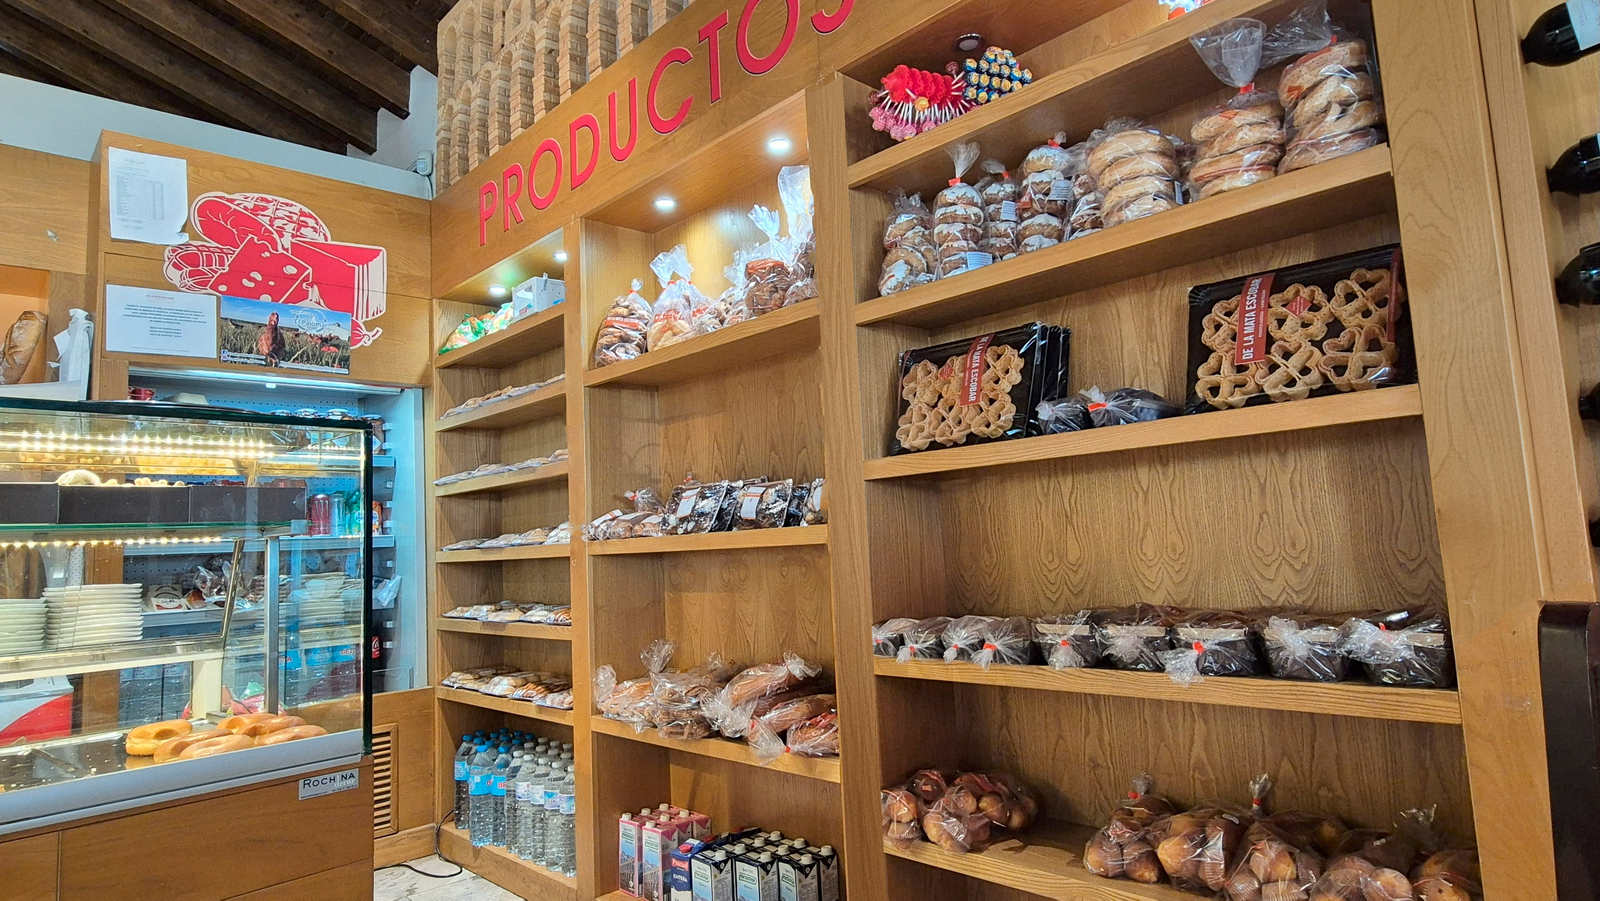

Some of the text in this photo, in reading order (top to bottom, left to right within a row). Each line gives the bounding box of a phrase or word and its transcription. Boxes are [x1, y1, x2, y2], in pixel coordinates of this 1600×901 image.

[1242, 277, 1263, 359] DE LA MATA ESCOBAR
[972, 351, 981, 368] MATA
[969, 369, 978, 401] ESCOBAR
